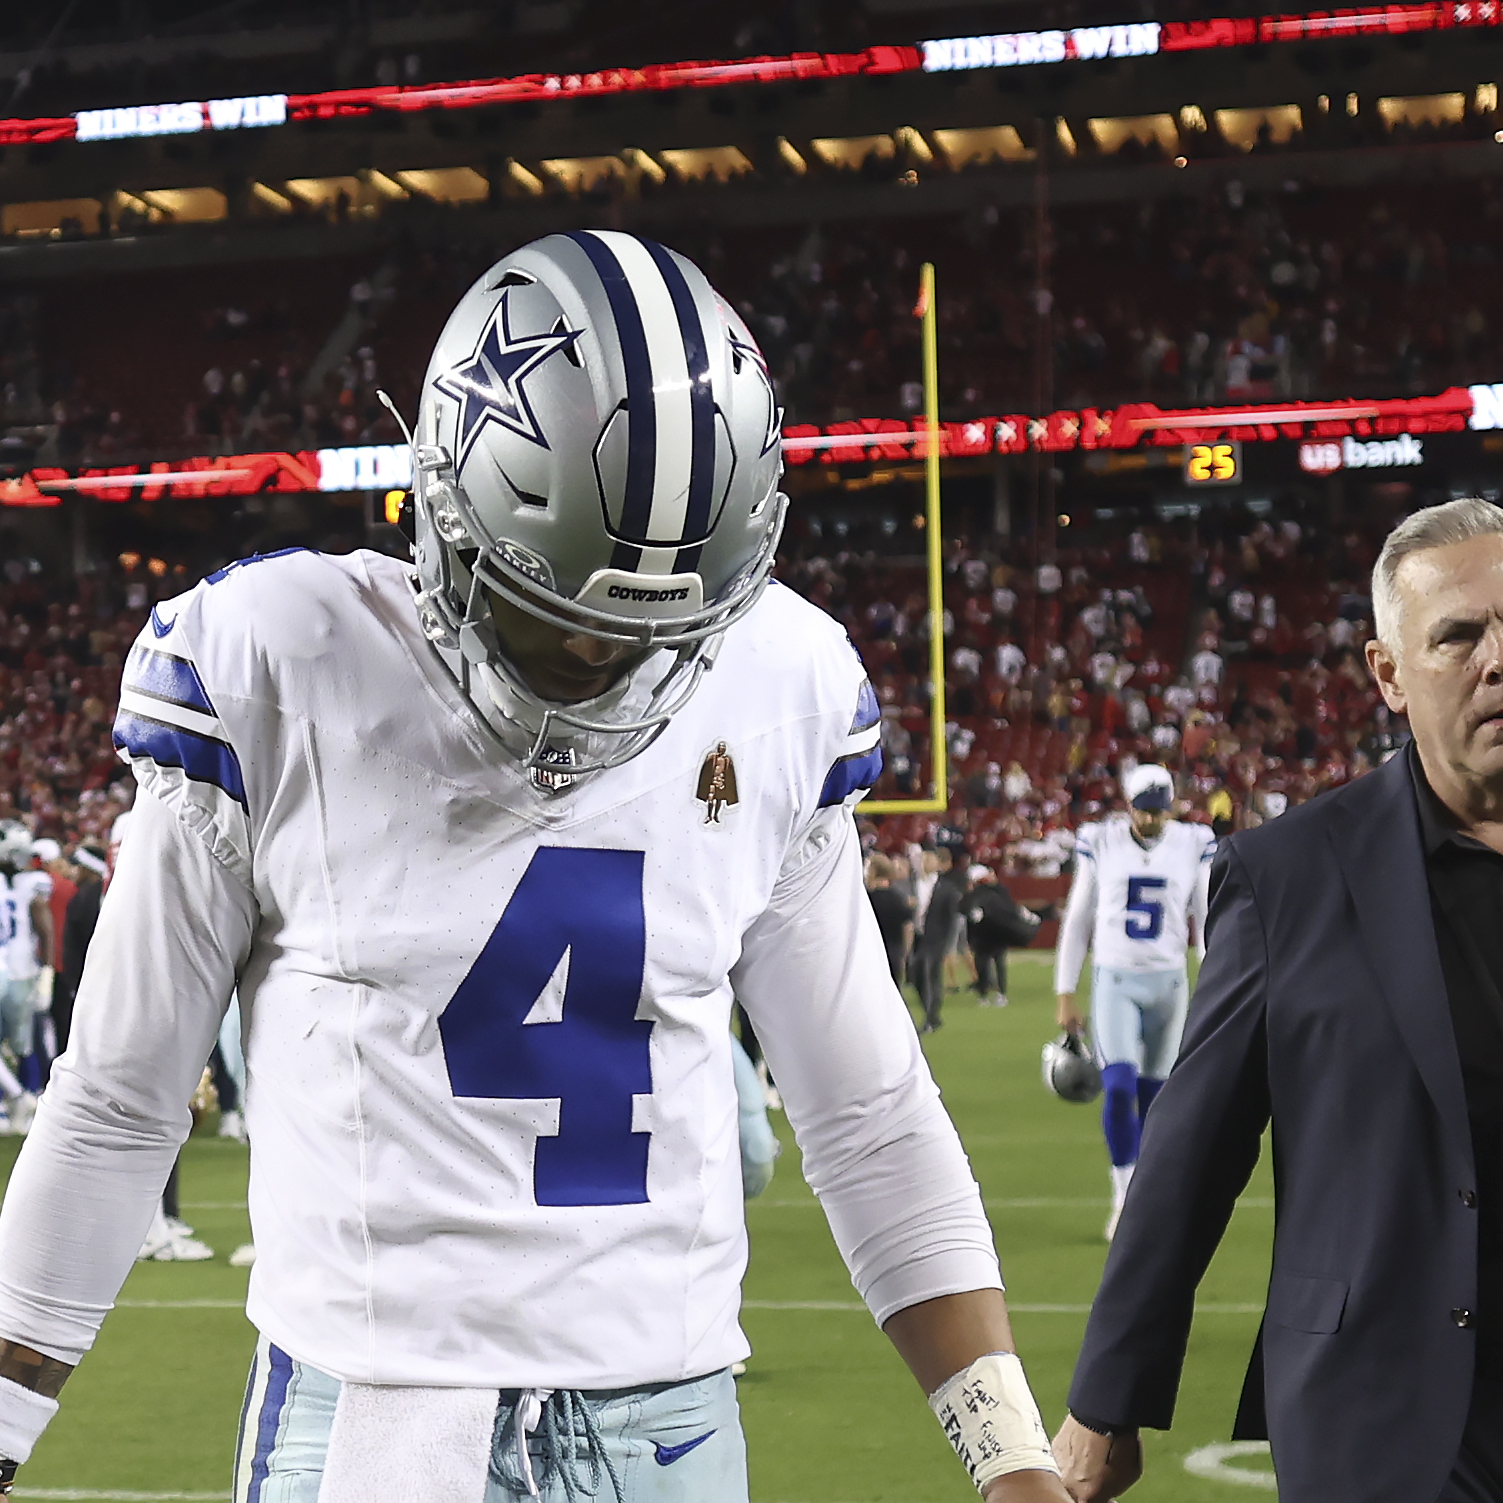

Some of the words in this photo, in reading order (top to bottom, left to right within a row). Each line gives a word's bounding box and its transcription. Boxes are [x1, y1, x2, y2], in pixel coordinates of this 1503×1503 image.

[922, 29, 1065, 72] NINERS
[1071, 22, 1162, 60] WIN
[75, 102, 203, 142] NINERS
[209, 94, 287, 130] WIN
[1188, 445, 1236, 481] 25
[1300, 442, 1342, 470] us
[1343, 433, 1424, 469] bank
[607, 584, 690, 602] COWBOYS
[1125, 875, 1167, 941] 5
[439, 846, 654, 1207] 4
